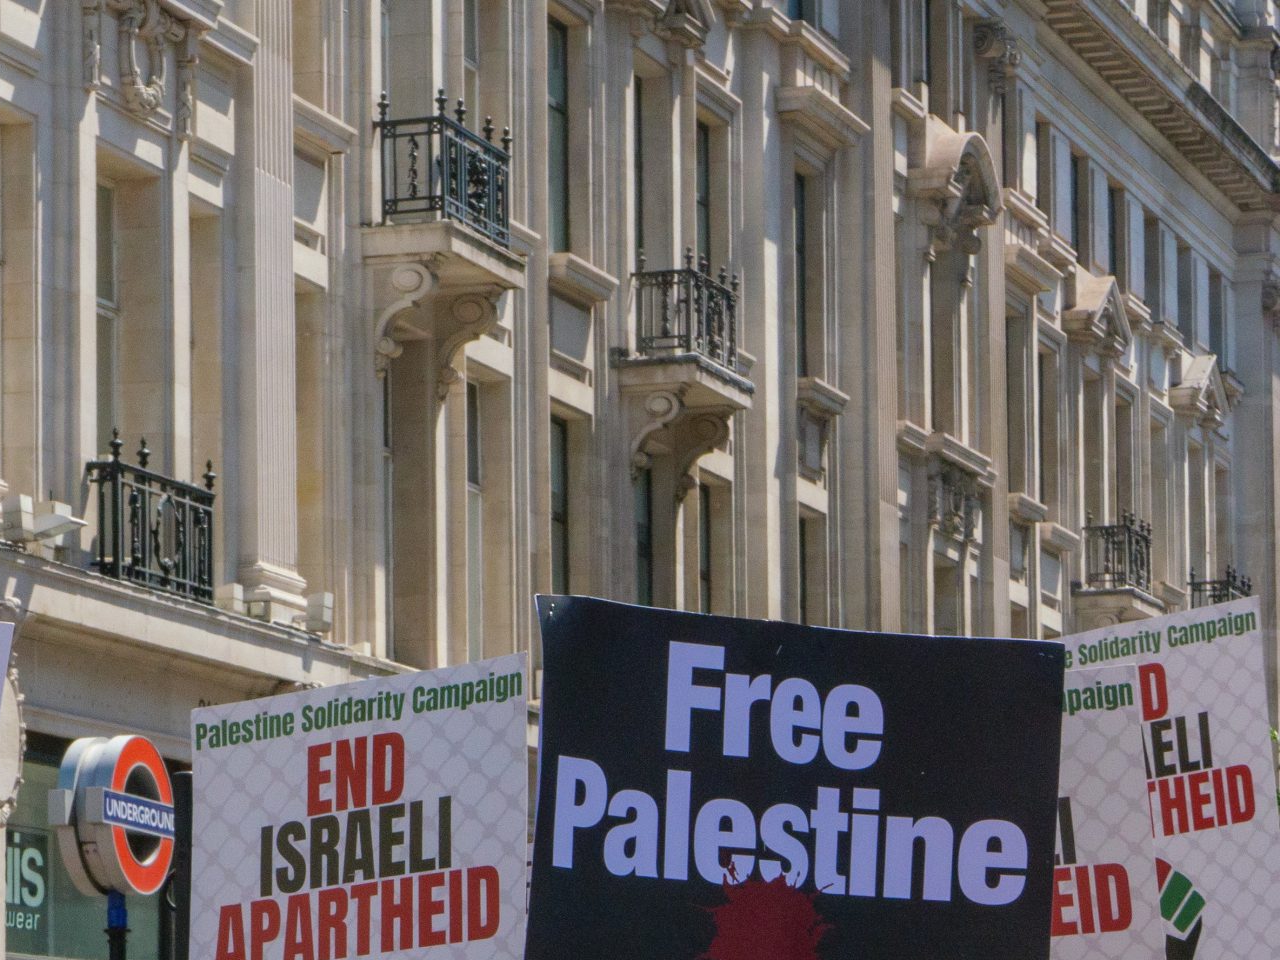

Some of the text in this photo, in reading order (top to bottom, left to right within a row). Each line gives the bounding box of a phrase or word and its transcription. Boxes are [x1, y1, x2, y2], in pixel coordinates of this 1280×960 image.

[1078, 630, 1161, 667] Solidarity
[1167, 610, 1256, 648] Campaign
[195, 671, 523, 750] Palestine Solidarity Campaign
[665, 640, 884, 771] Free
[1061, 681, 1134, 716] paign
[307, 732, 405, 817] END
[1141, 711, 1213, 780] ELI
[552, 755, 1029, 905] Palestine
[1147, 764, 1255, 838] HEID
[260, 796, 452, 897] ISRAELI
